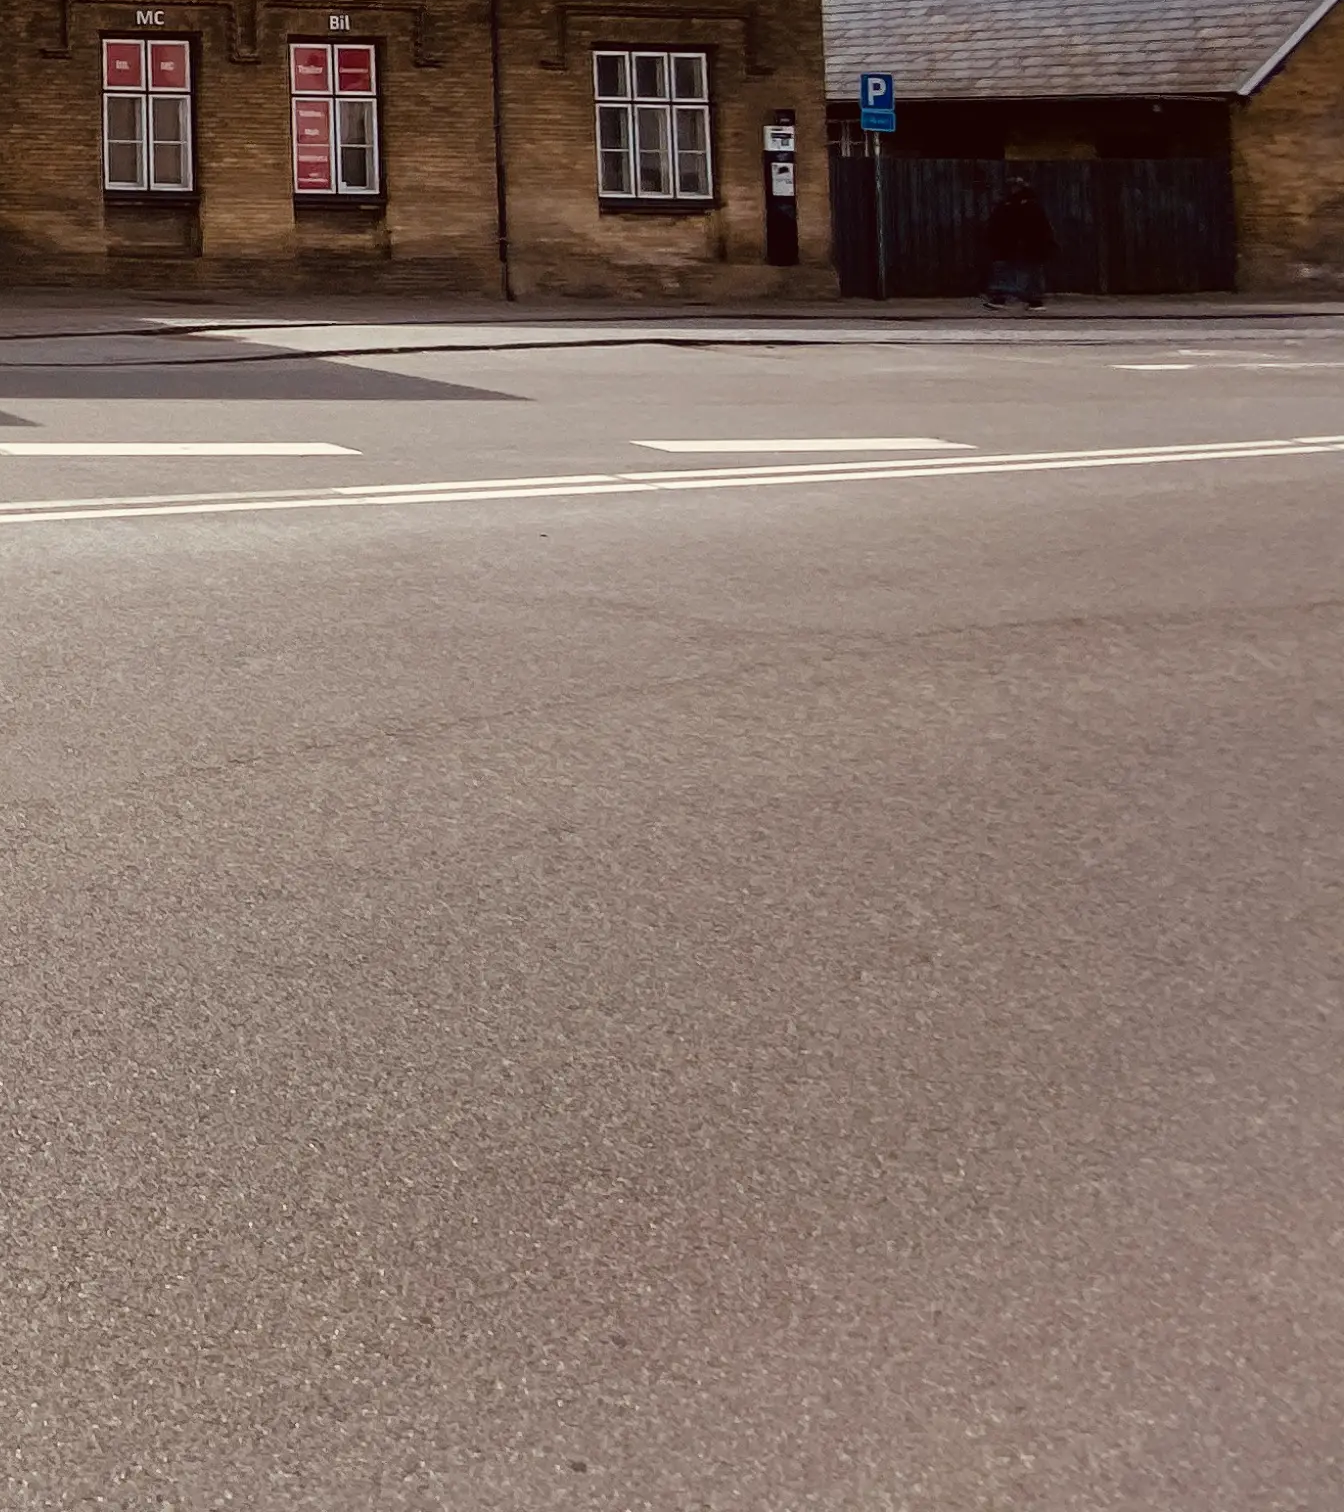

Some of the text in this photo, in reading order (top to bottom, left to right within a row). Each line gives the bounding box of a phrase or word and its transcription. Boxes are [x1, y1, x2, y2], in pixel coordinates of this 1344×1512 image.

[136, 10, 165, 26] MC
[329, 14, 350, 31] Bil
[867, 77, 887, 106] P
